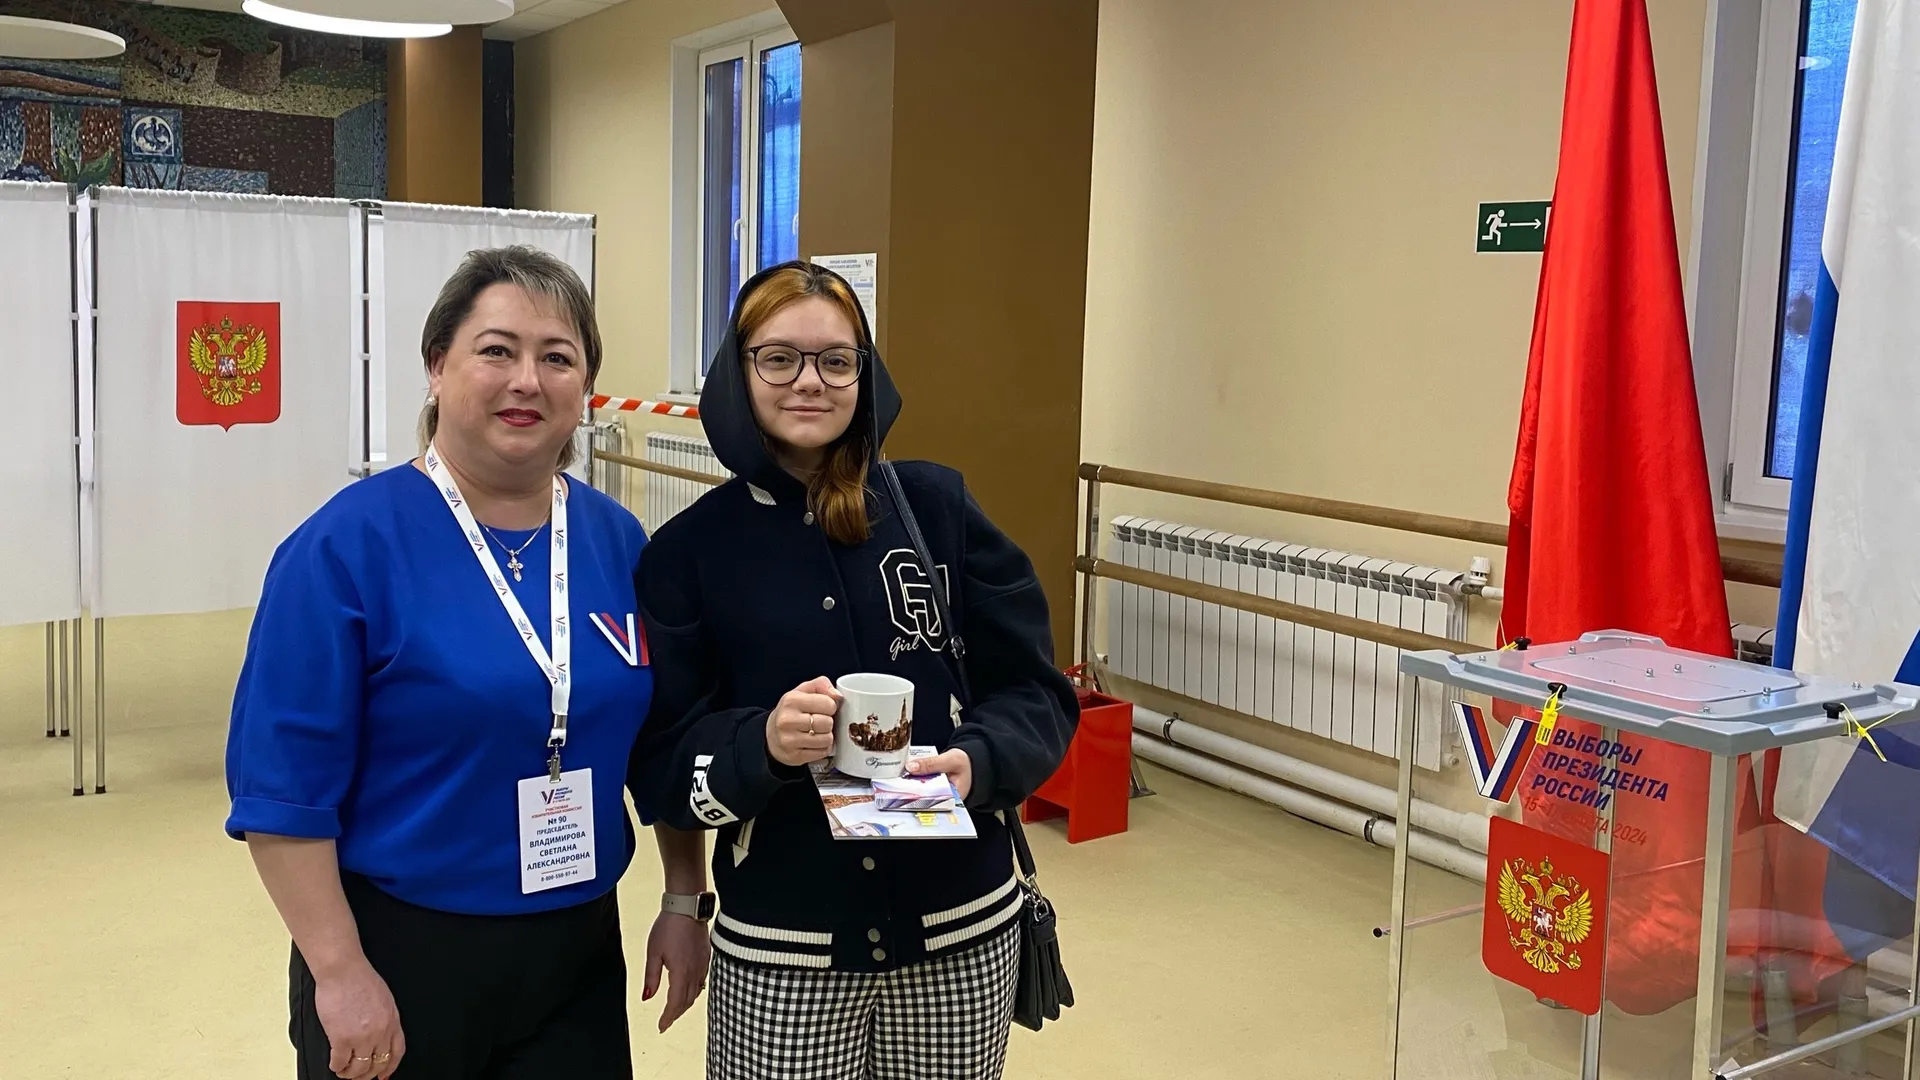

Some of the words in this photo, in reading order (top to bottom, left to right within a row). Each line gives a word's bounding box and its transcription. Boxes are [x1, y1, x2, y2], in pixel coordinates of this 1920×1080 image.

[890, 635, 920, 661] Girl
[1553, 729, 1643, 766] ВЫБОРЫ
[1542, 752, 1669, 802] ПРЕЗИДЕНТА
[1531, 775, 1611, 811] РОССИИ
[536, 823, 578, 836] ПРЕДСЕДАТЕЛЬ
[547, 818, 557, 826] №
[558, 815, 567, 824] 90
[529, 831, 586, 848] ВЛАДИМИРОВА
[1612, 823, 1648, 846] 2024
[539, 843, 577, 857] СВЕТЛАНА
[526, 851, 590, 871] АЛЕКСАНДРОВНА
